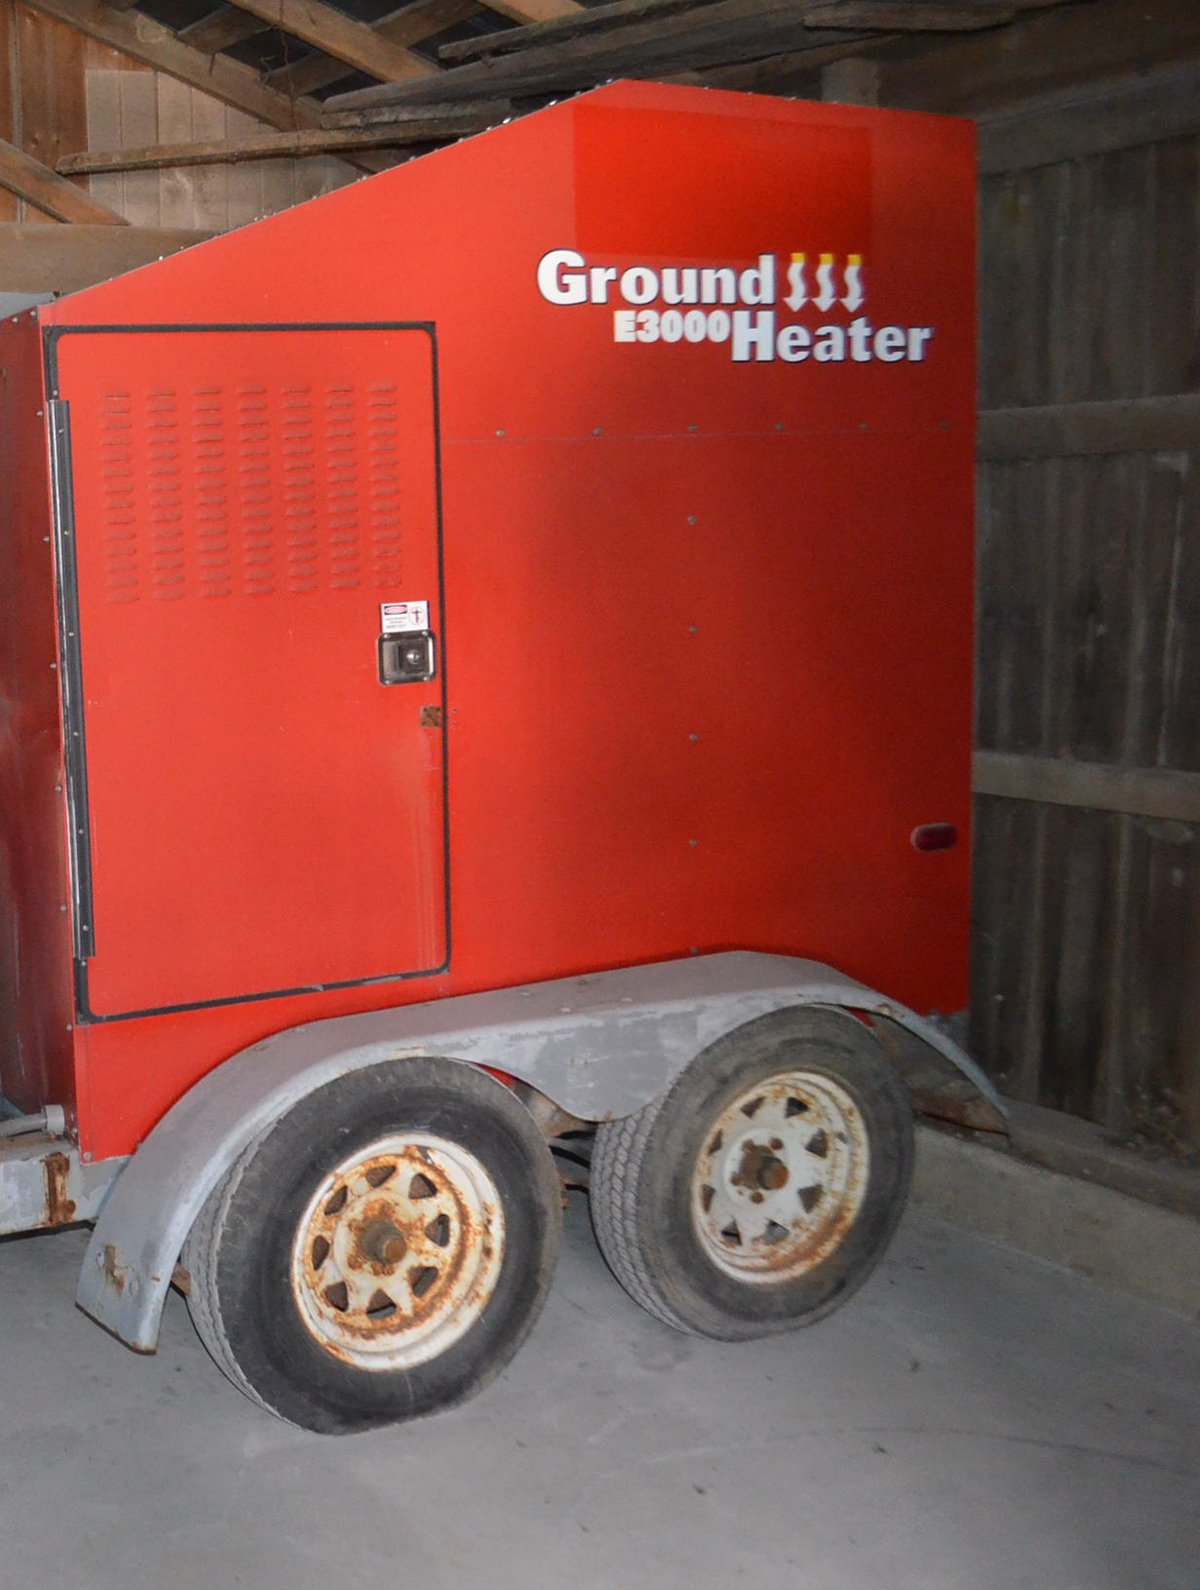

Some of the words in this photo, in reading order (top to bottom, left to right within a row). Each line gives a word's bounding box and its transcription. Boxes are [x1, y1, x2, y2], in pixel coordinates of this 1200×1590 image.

[537, 248, 776, 305] Ground
[613, 310, 730, 343] E3000
[731, 310, 932, 362] Heater
